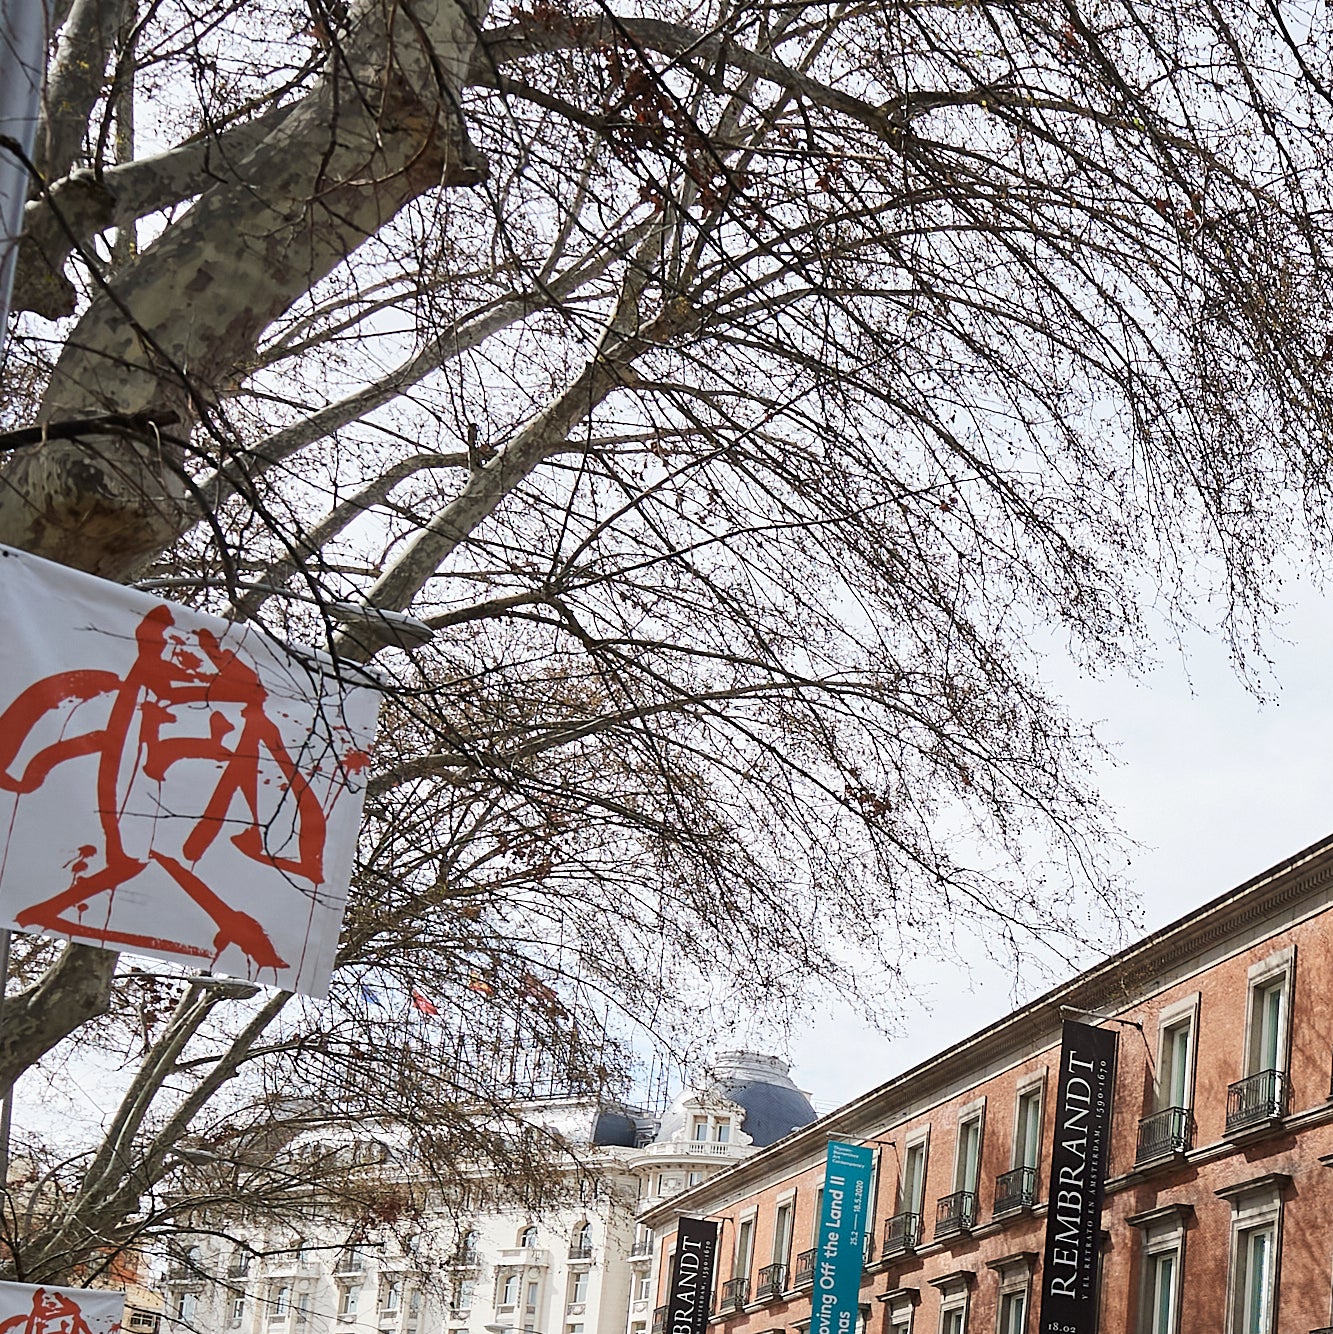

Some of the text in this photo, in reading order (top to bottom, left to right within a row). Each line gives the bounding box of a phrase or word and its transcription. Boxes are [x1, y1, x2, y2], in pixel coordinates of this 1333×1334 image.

[1096, 1060, 1108, 1118] 1590-1670
[830, 1175, 845, 1186] II
[1051, 1050, 1095, 1299] REMBRANDT
[826, 1189, 844, 1228] Land
[850, 1180, 863, 1246] 25.2 18.5.2020
[1087, 1201, 1095, 1214] EN
[823, 1232, 839, 1258] the
[1084, 1220, 1094, 1269] RETRATO
[820, 1262, 836, 1290] Off
[1082, 1275, 1090, 1288] EL
[1048, 1322, 1076, 1333] 18.02
